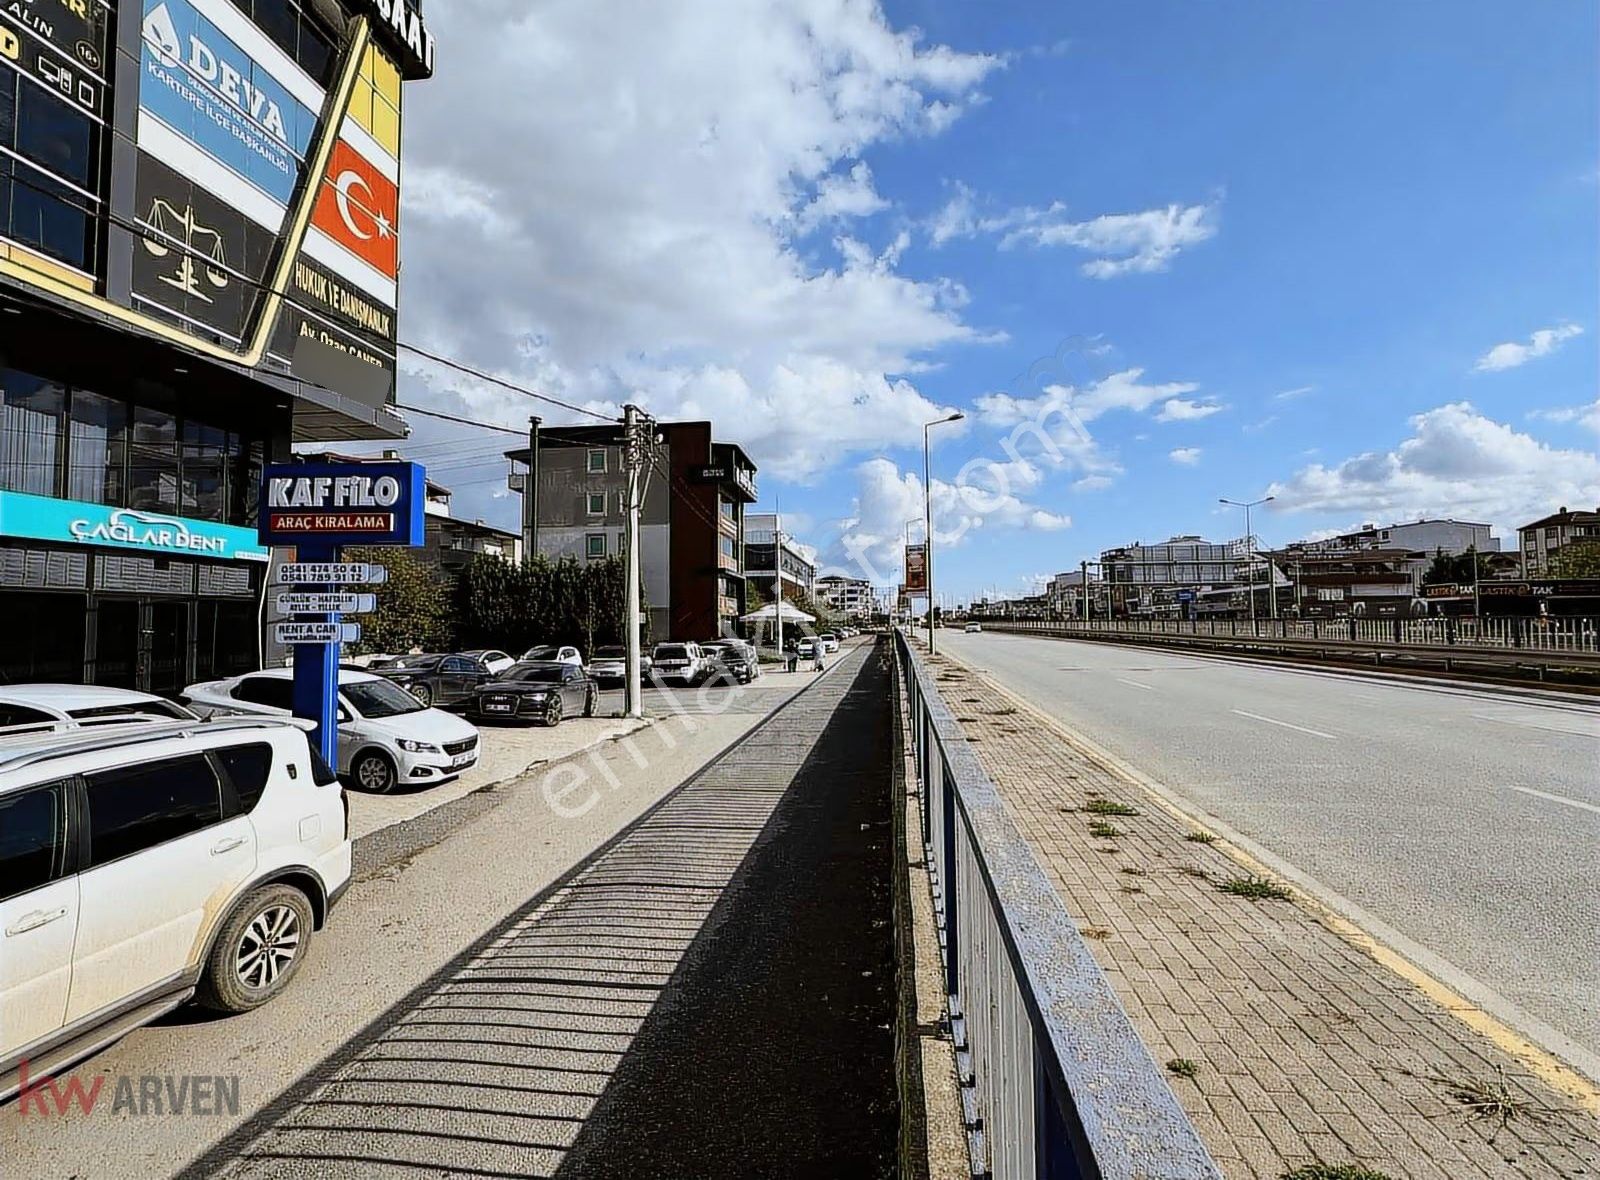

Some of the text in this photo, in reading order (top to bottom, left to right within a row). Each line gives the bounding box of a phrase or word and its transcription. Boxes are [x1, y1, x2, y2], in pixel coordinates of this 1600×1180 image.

[148, 61, 205, 112] KARTEPE
[189, 34, 287, 143] DEVA
[295, 261, 327, 302] HUKUK
[268, 476, 333, 508] KAF
[276, 516, 385, 530] ARAÇ KIRALAMA
[174, 531, 229, 554] DENT
[278, 624, 305, 634] RENT
